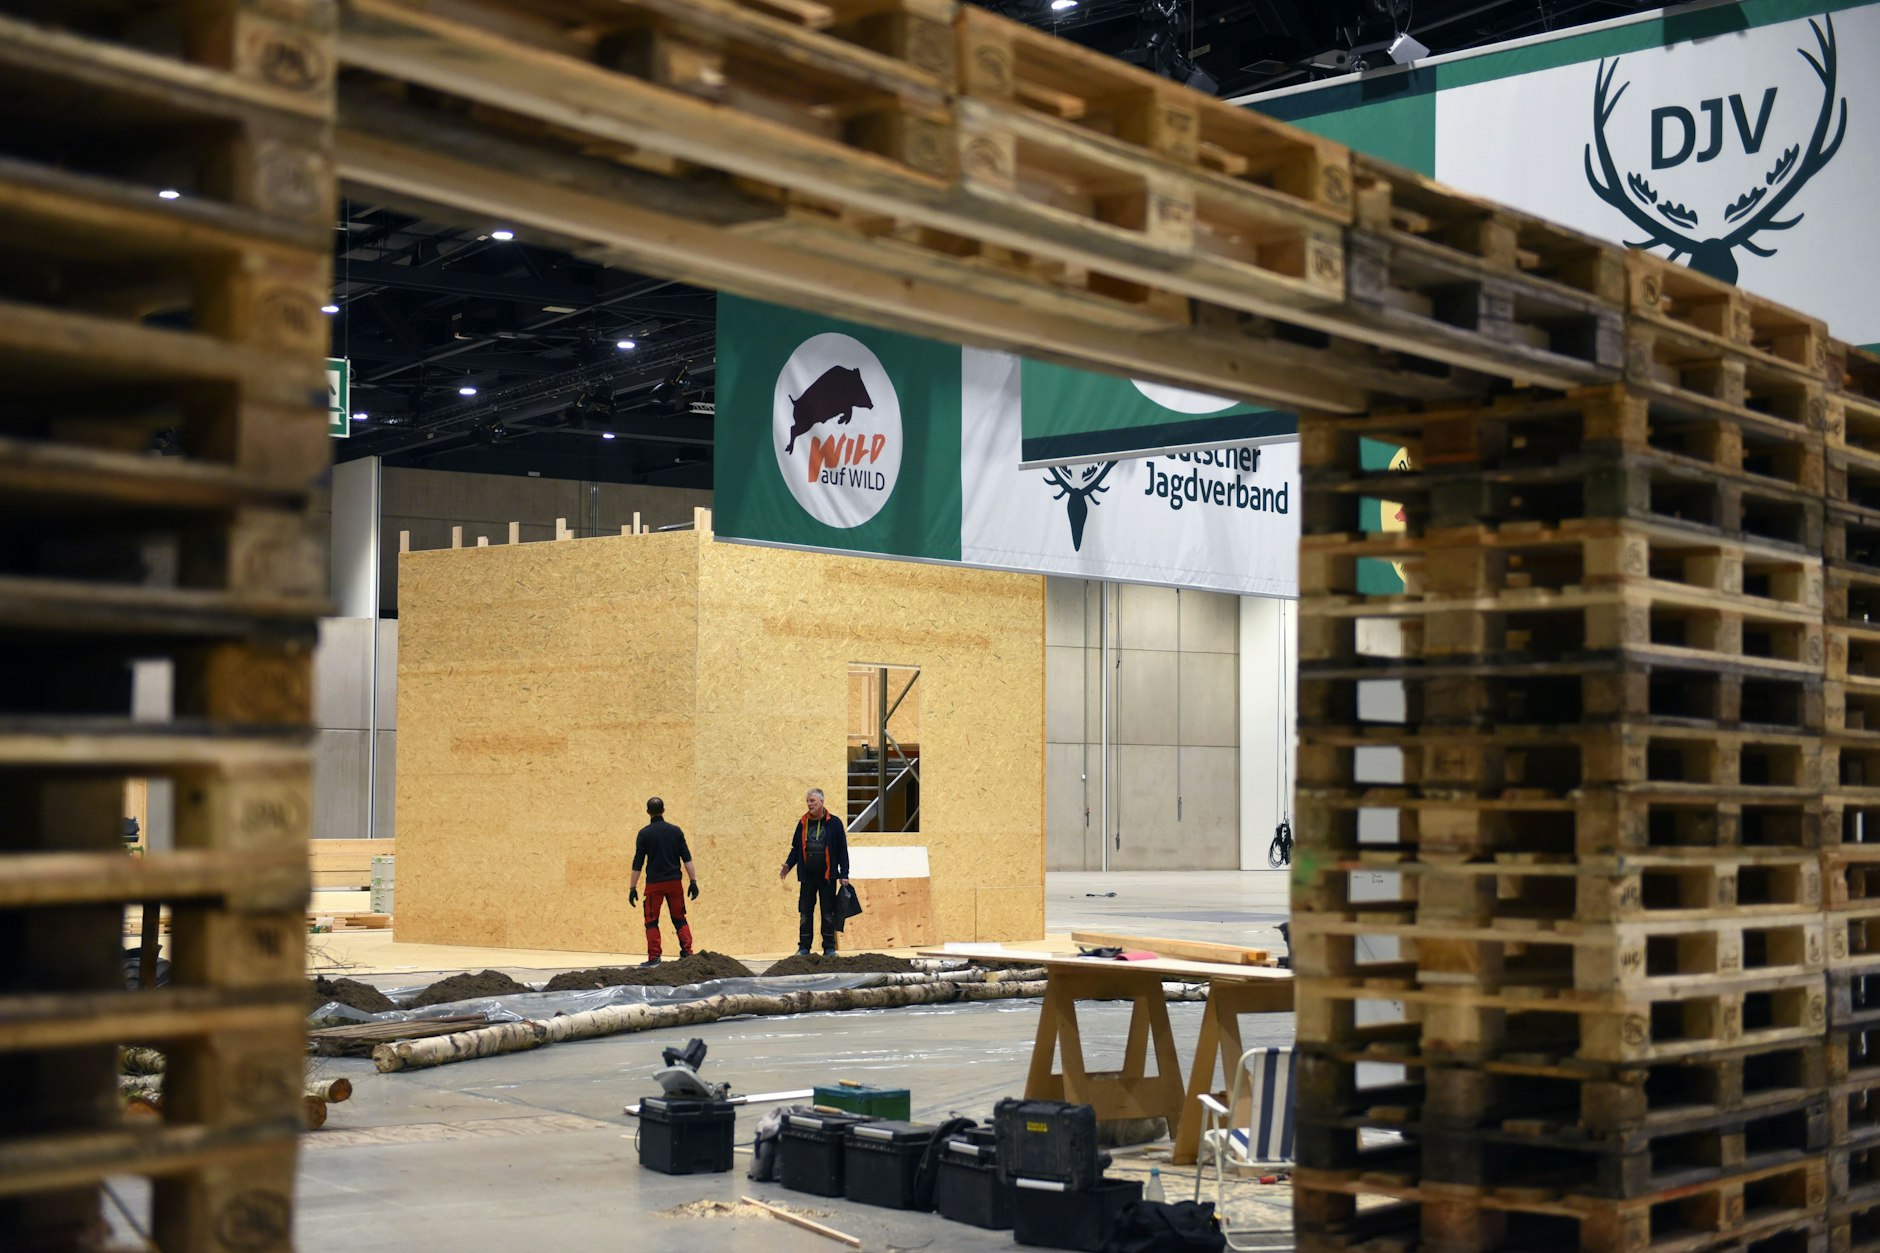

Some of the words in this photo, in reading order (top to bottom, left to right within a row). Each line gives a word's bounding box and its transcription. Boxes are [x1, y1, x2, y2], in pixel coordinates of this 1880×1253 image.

[1651, 87, 1778, 170] DJV
[808, 432, 885, 482] WILD
[821, 467, 846, 486] auf
[849, 468, 885, 491] WILD
[1145, 461, 1288, 514] Jagdverband
